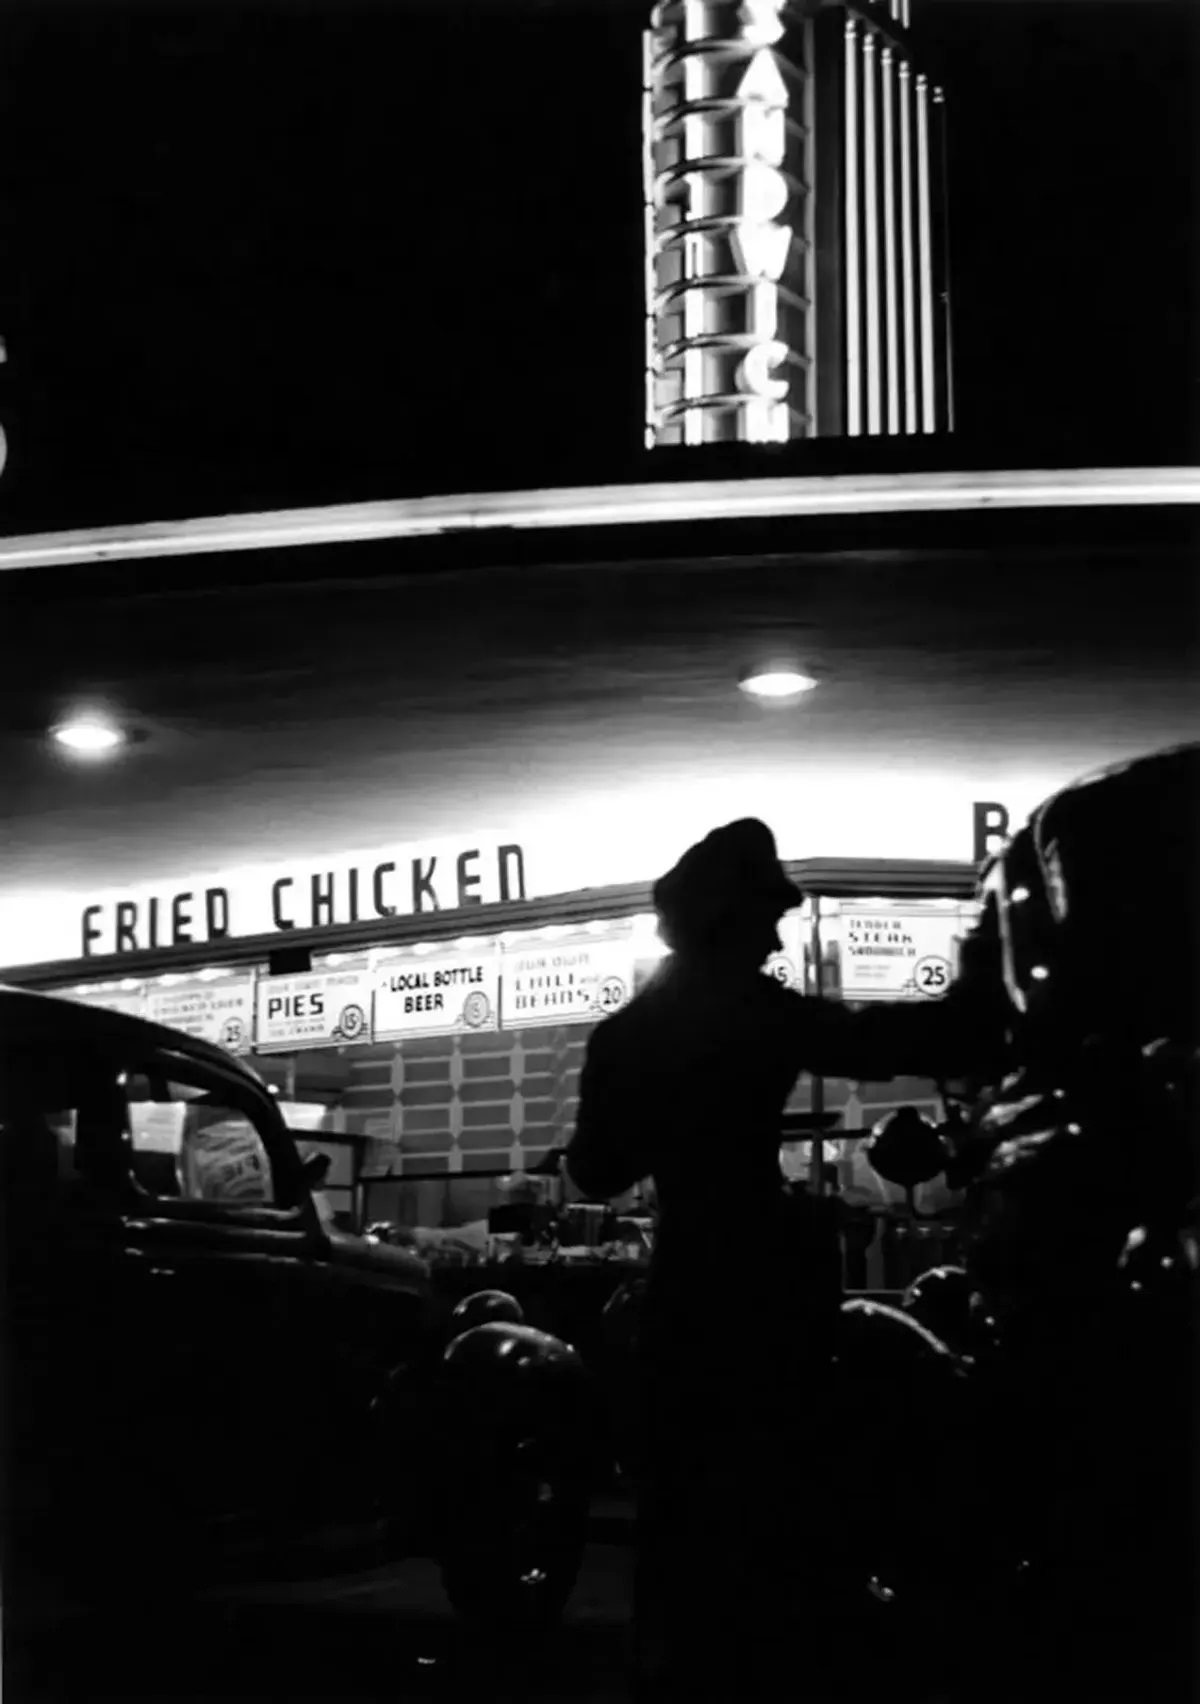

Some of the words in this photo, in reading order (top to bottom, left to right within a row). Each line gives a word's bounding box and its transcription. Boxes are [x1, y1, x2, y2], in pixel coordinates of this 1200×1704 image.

[82, 887, 229, 958] FRIED
[272, 844, 526, 931] CHICKEN
[390, 973, 430, 992] LOCAL
[433, 966, 483, 988] BOTTLE
[920, 965, 945, 986] 25
[267, 992, 324, 1020] PIES
[403, 992, 444, 1014] BEER
[515, 988, 590, 1010] BEANS
[603, 985, 622, 1005] 20
[226, 1023, 242, 1043] 25
